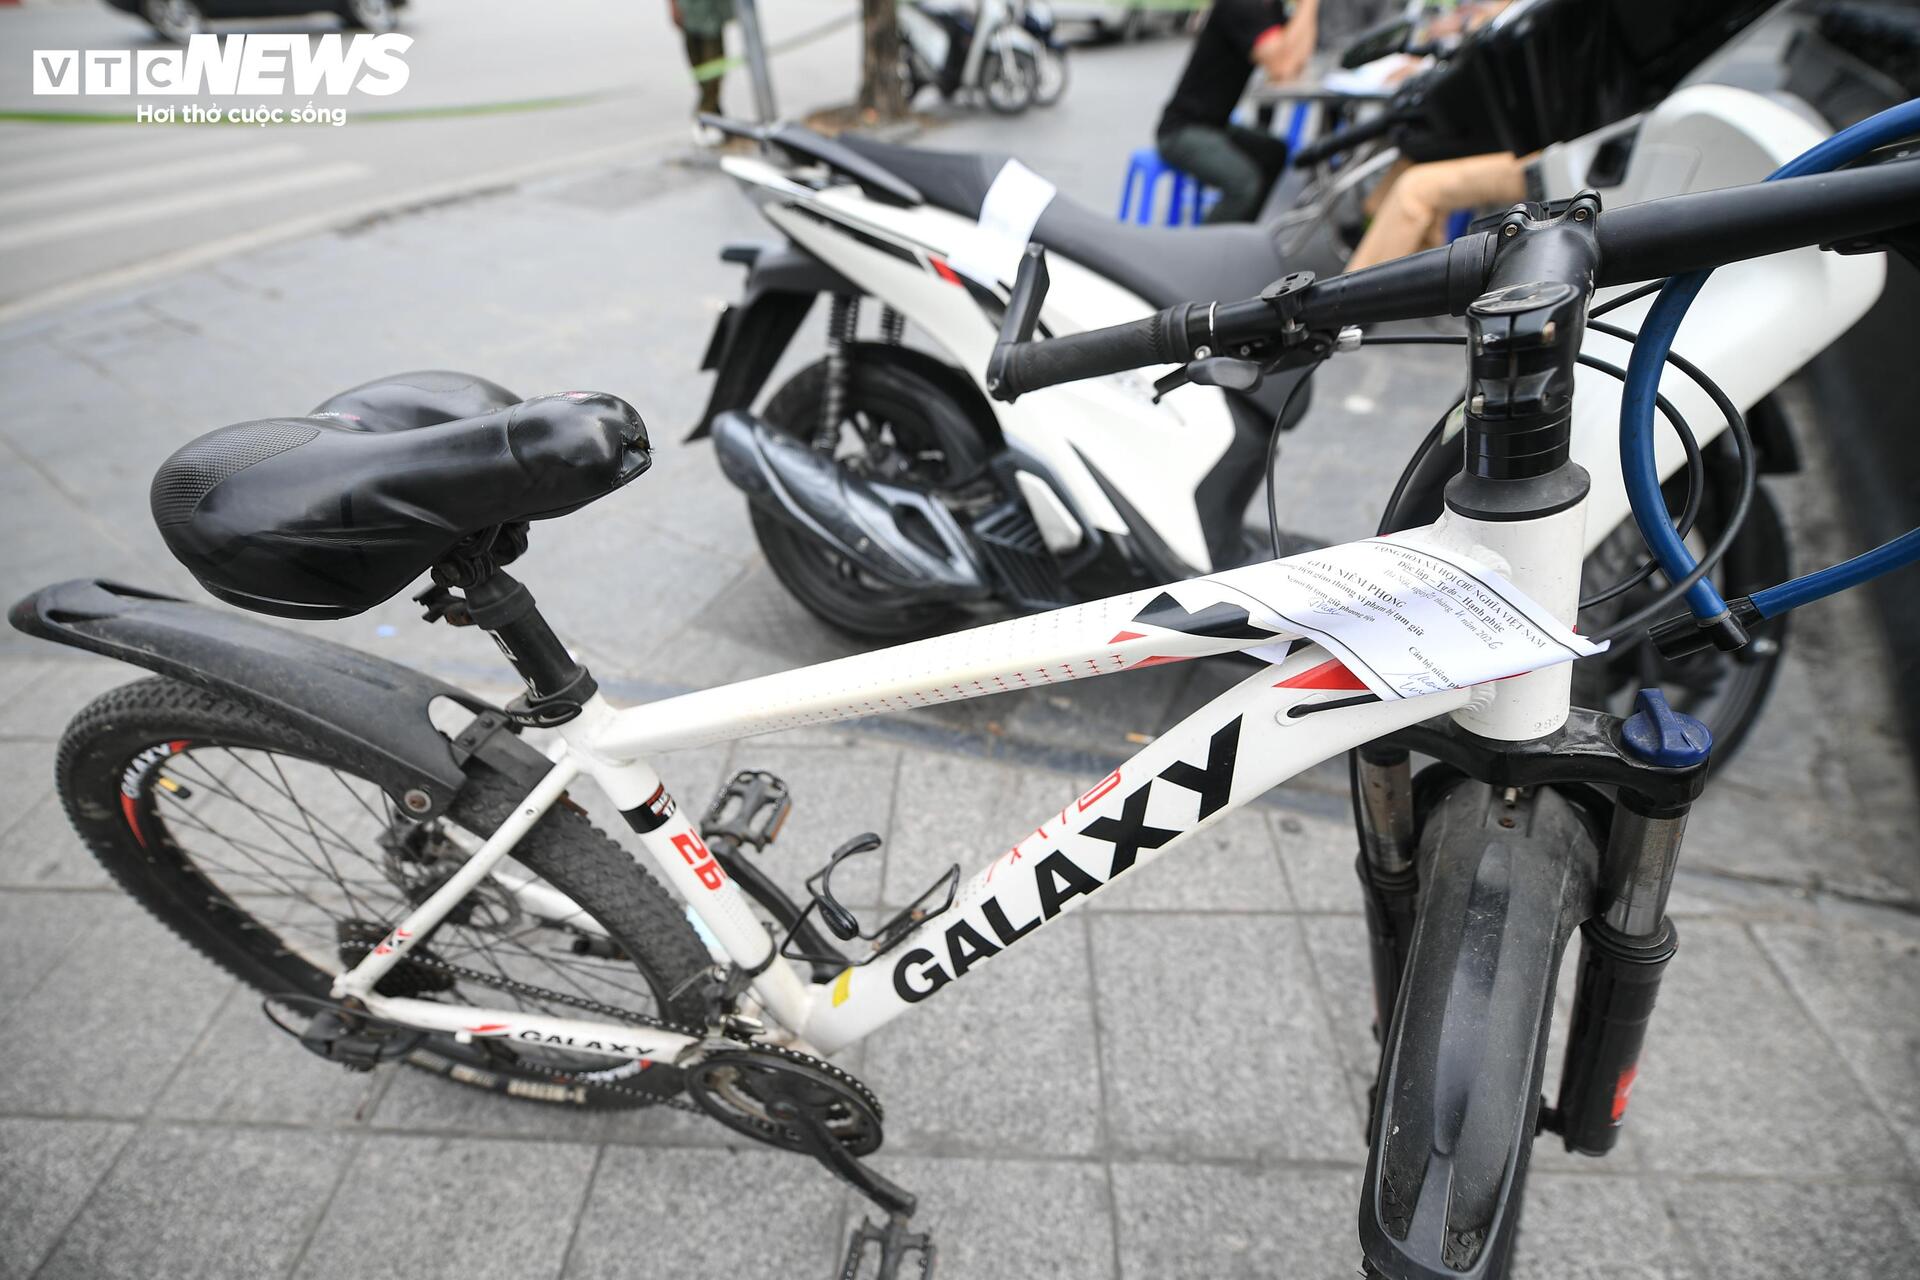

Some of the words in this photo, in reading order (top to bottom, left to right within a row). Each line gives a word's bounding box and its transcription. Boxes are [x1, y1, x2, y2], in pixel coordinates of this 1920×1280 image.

[1367, 583, 1407, 609] PHONG
[1393, 612, 1409, 626] tạm
[1407, 624, 1424, 637] giữ
[1462, 596, 1485, 616] Hạnh
[1480, 615, 1505, 633] phúc
[1475, 589, 1502, 614] NGHĨA
[1526, 629, 1546, 648] NAM
[893, 713, 1243, 1003] GALAXY
[520, 1029, 655, 1055] GALAXY
